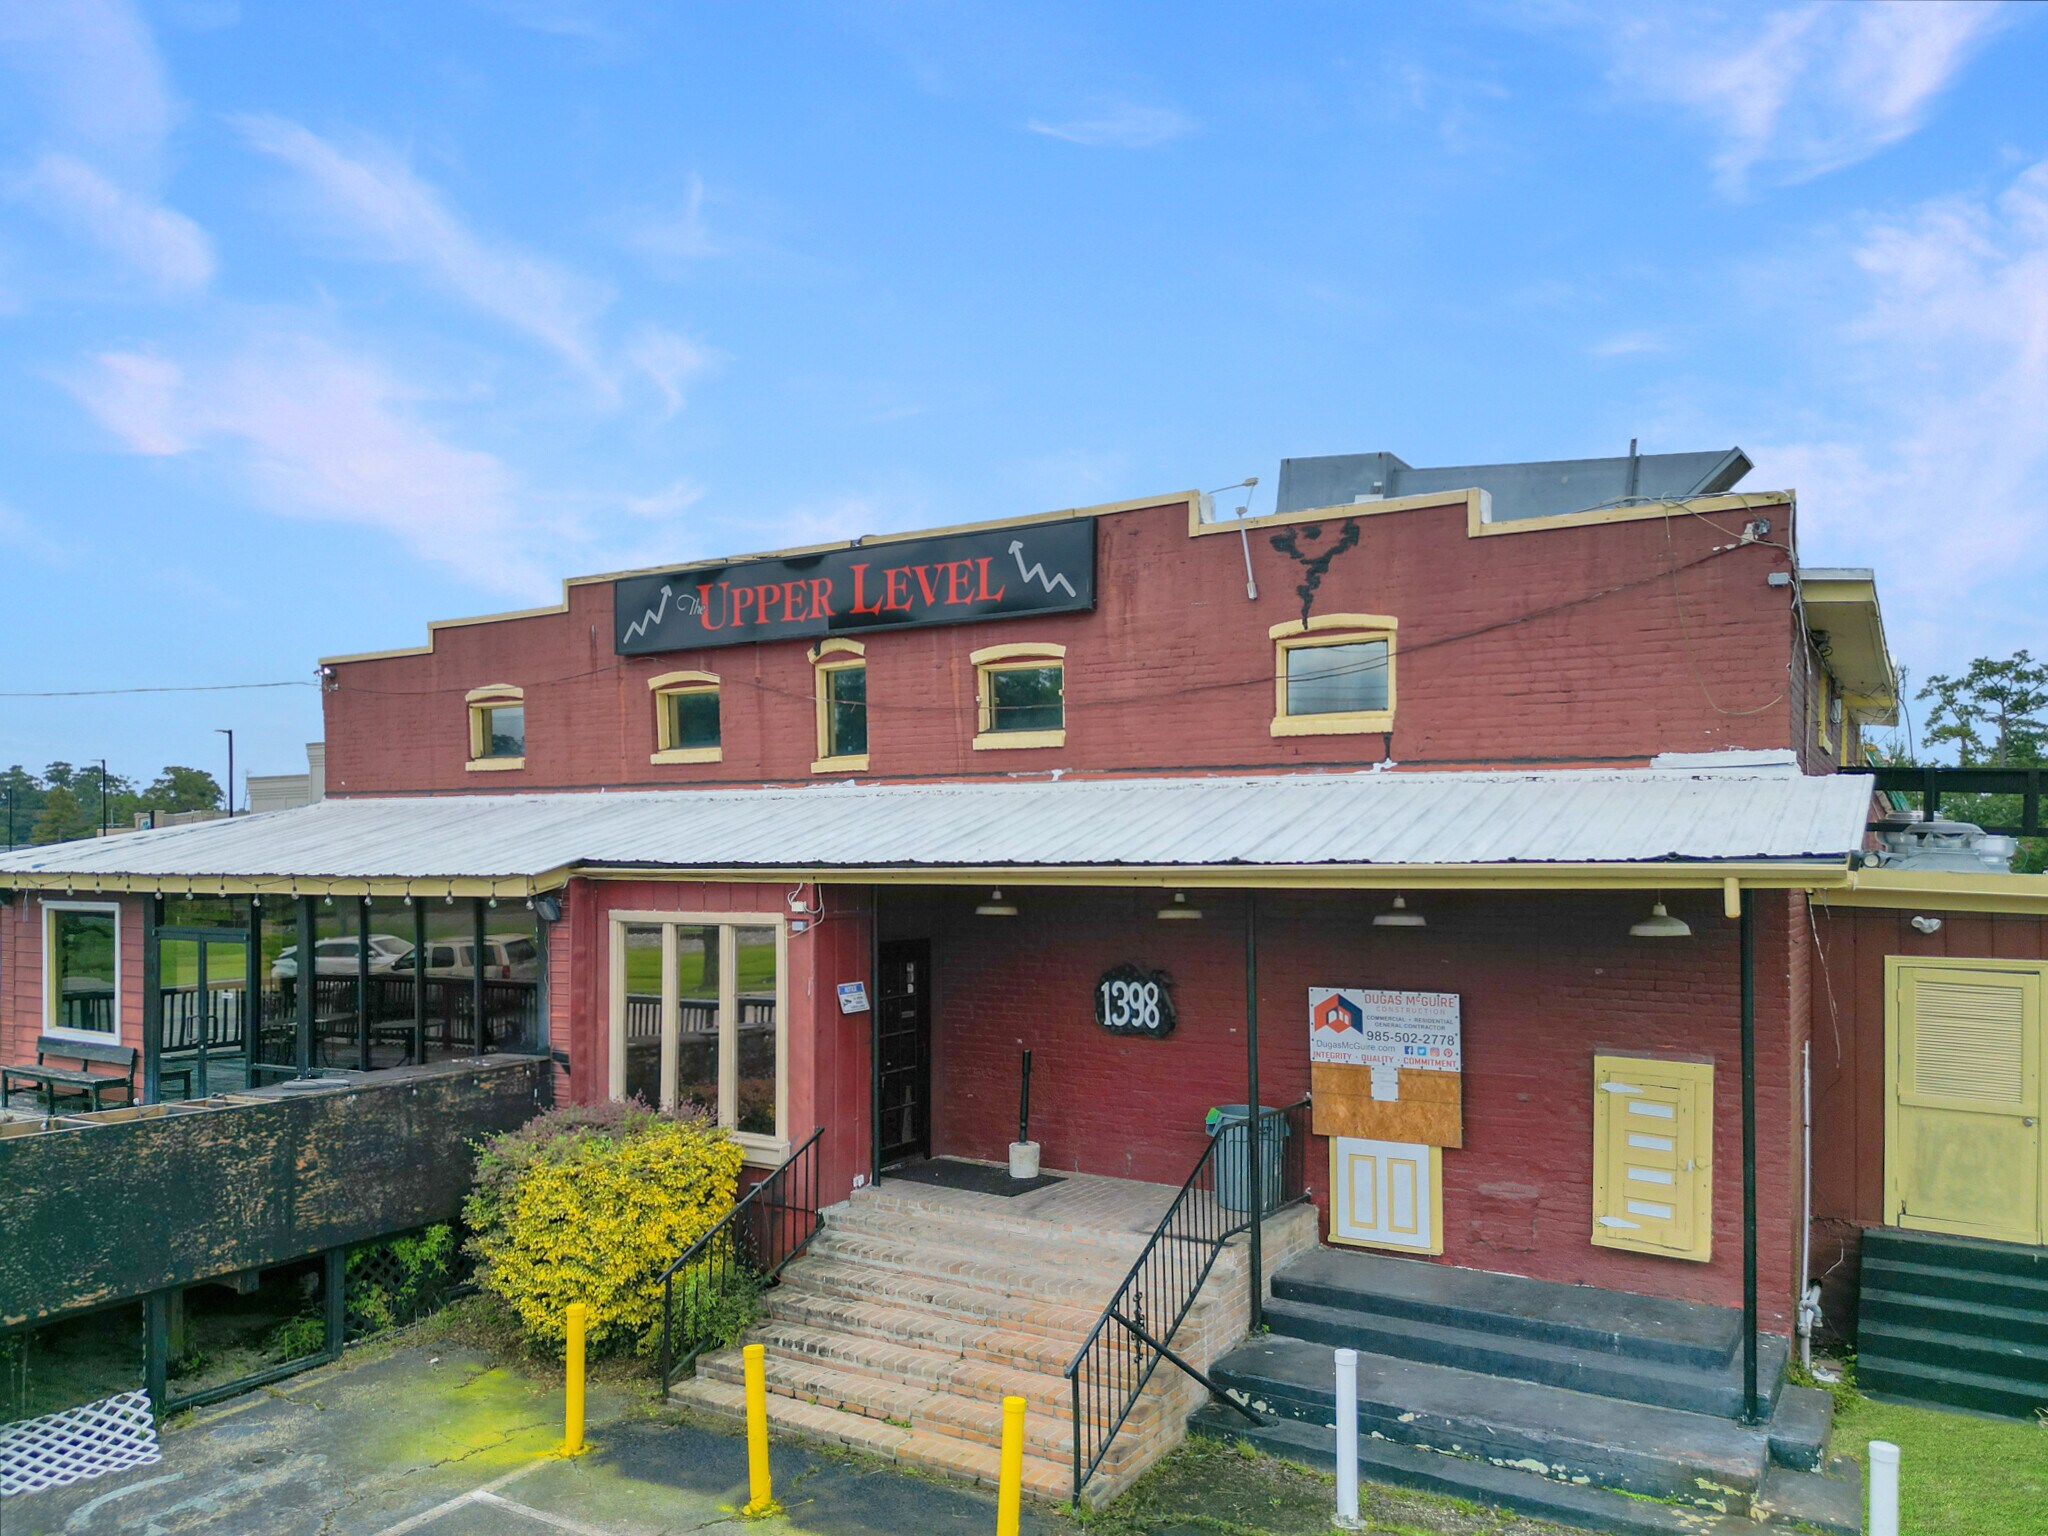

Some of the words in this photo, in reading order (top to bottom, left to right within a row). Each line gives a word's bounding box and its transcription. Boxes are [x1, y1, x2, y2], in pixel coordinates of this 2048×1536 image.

[676, 594, 706, 616] The
[696, 577, 836, 631] UPPER
[849, 557, 1006, 616] LEVEL
[1101, 980, 1160, 1029] 1398
[1364, 993, 1402, 1006] DUGAS
[1406, 995, 1455, 1008] McGUIRE
[1376, 1006, 1446, 1015] CONSTRUCTION
[1403, 1023, 1446, 1031] CONTRACTOR
[1366, 1030, 1455, 1046] 985-502-2778
[1316, 1039, 1396, 1053] DugasMcGuire.com
[1313, 1051, 1352, 1060] INTEGRITY
[1361, 1054, 1394, 1063] QUALITY
[1403, 1056, 1456, 1068] COMMITMENT
